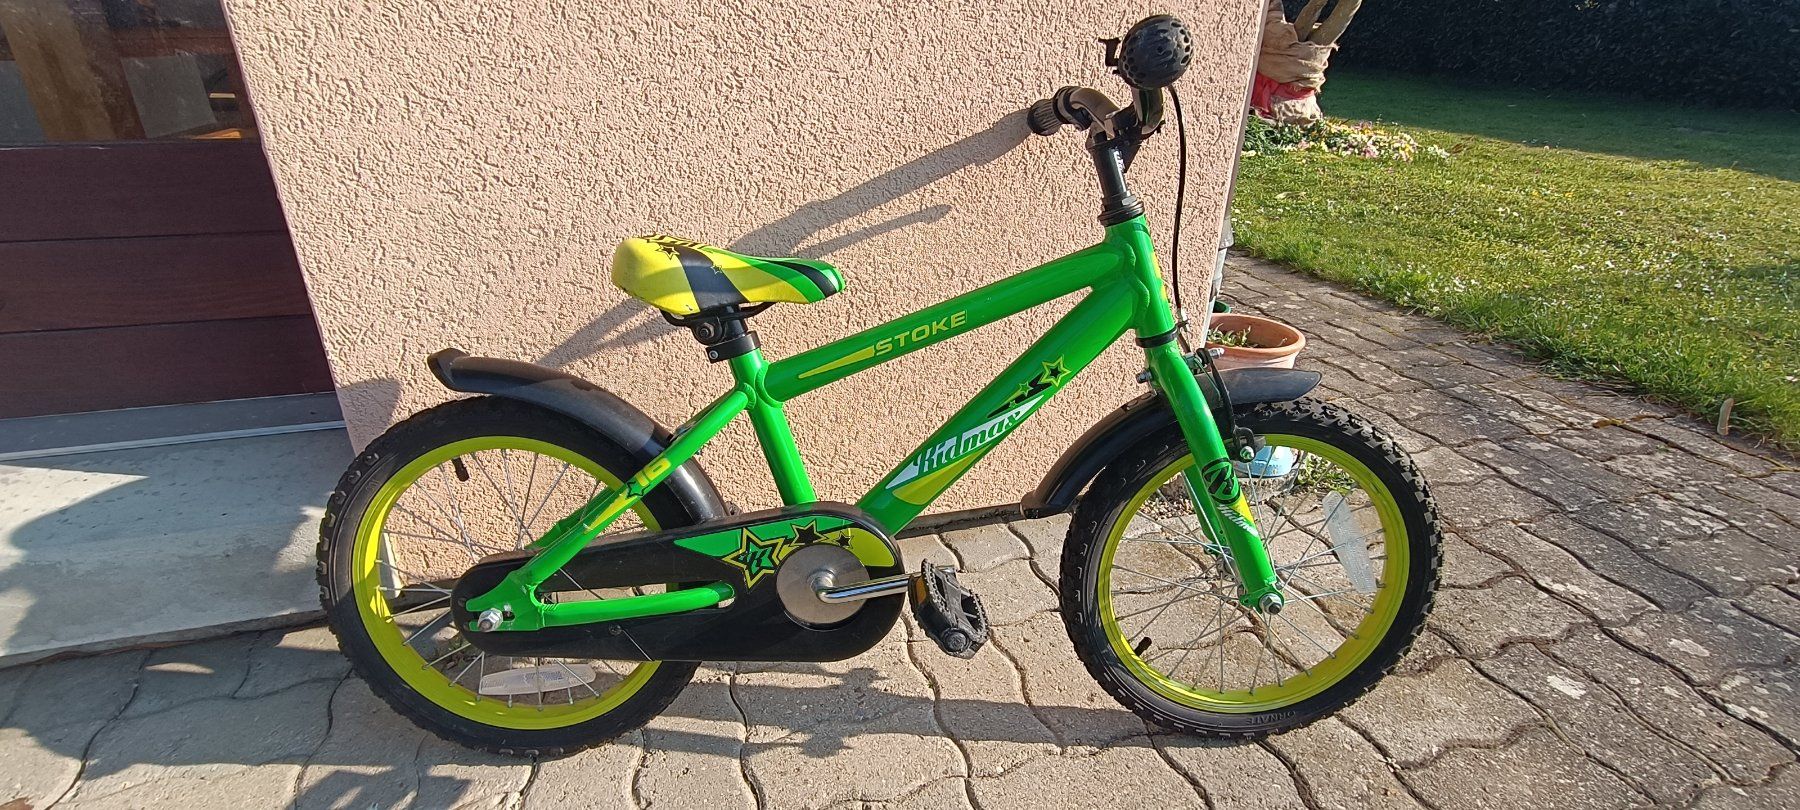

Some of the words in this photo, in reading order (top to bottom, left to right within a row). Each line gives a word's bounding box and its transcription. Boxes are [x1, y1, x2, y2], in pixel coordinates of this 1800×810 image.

[875, 310, 966, 356] STOKE
[911, 409, 1022, 474] Kidmax
[635, 457, 671, 487] 16
